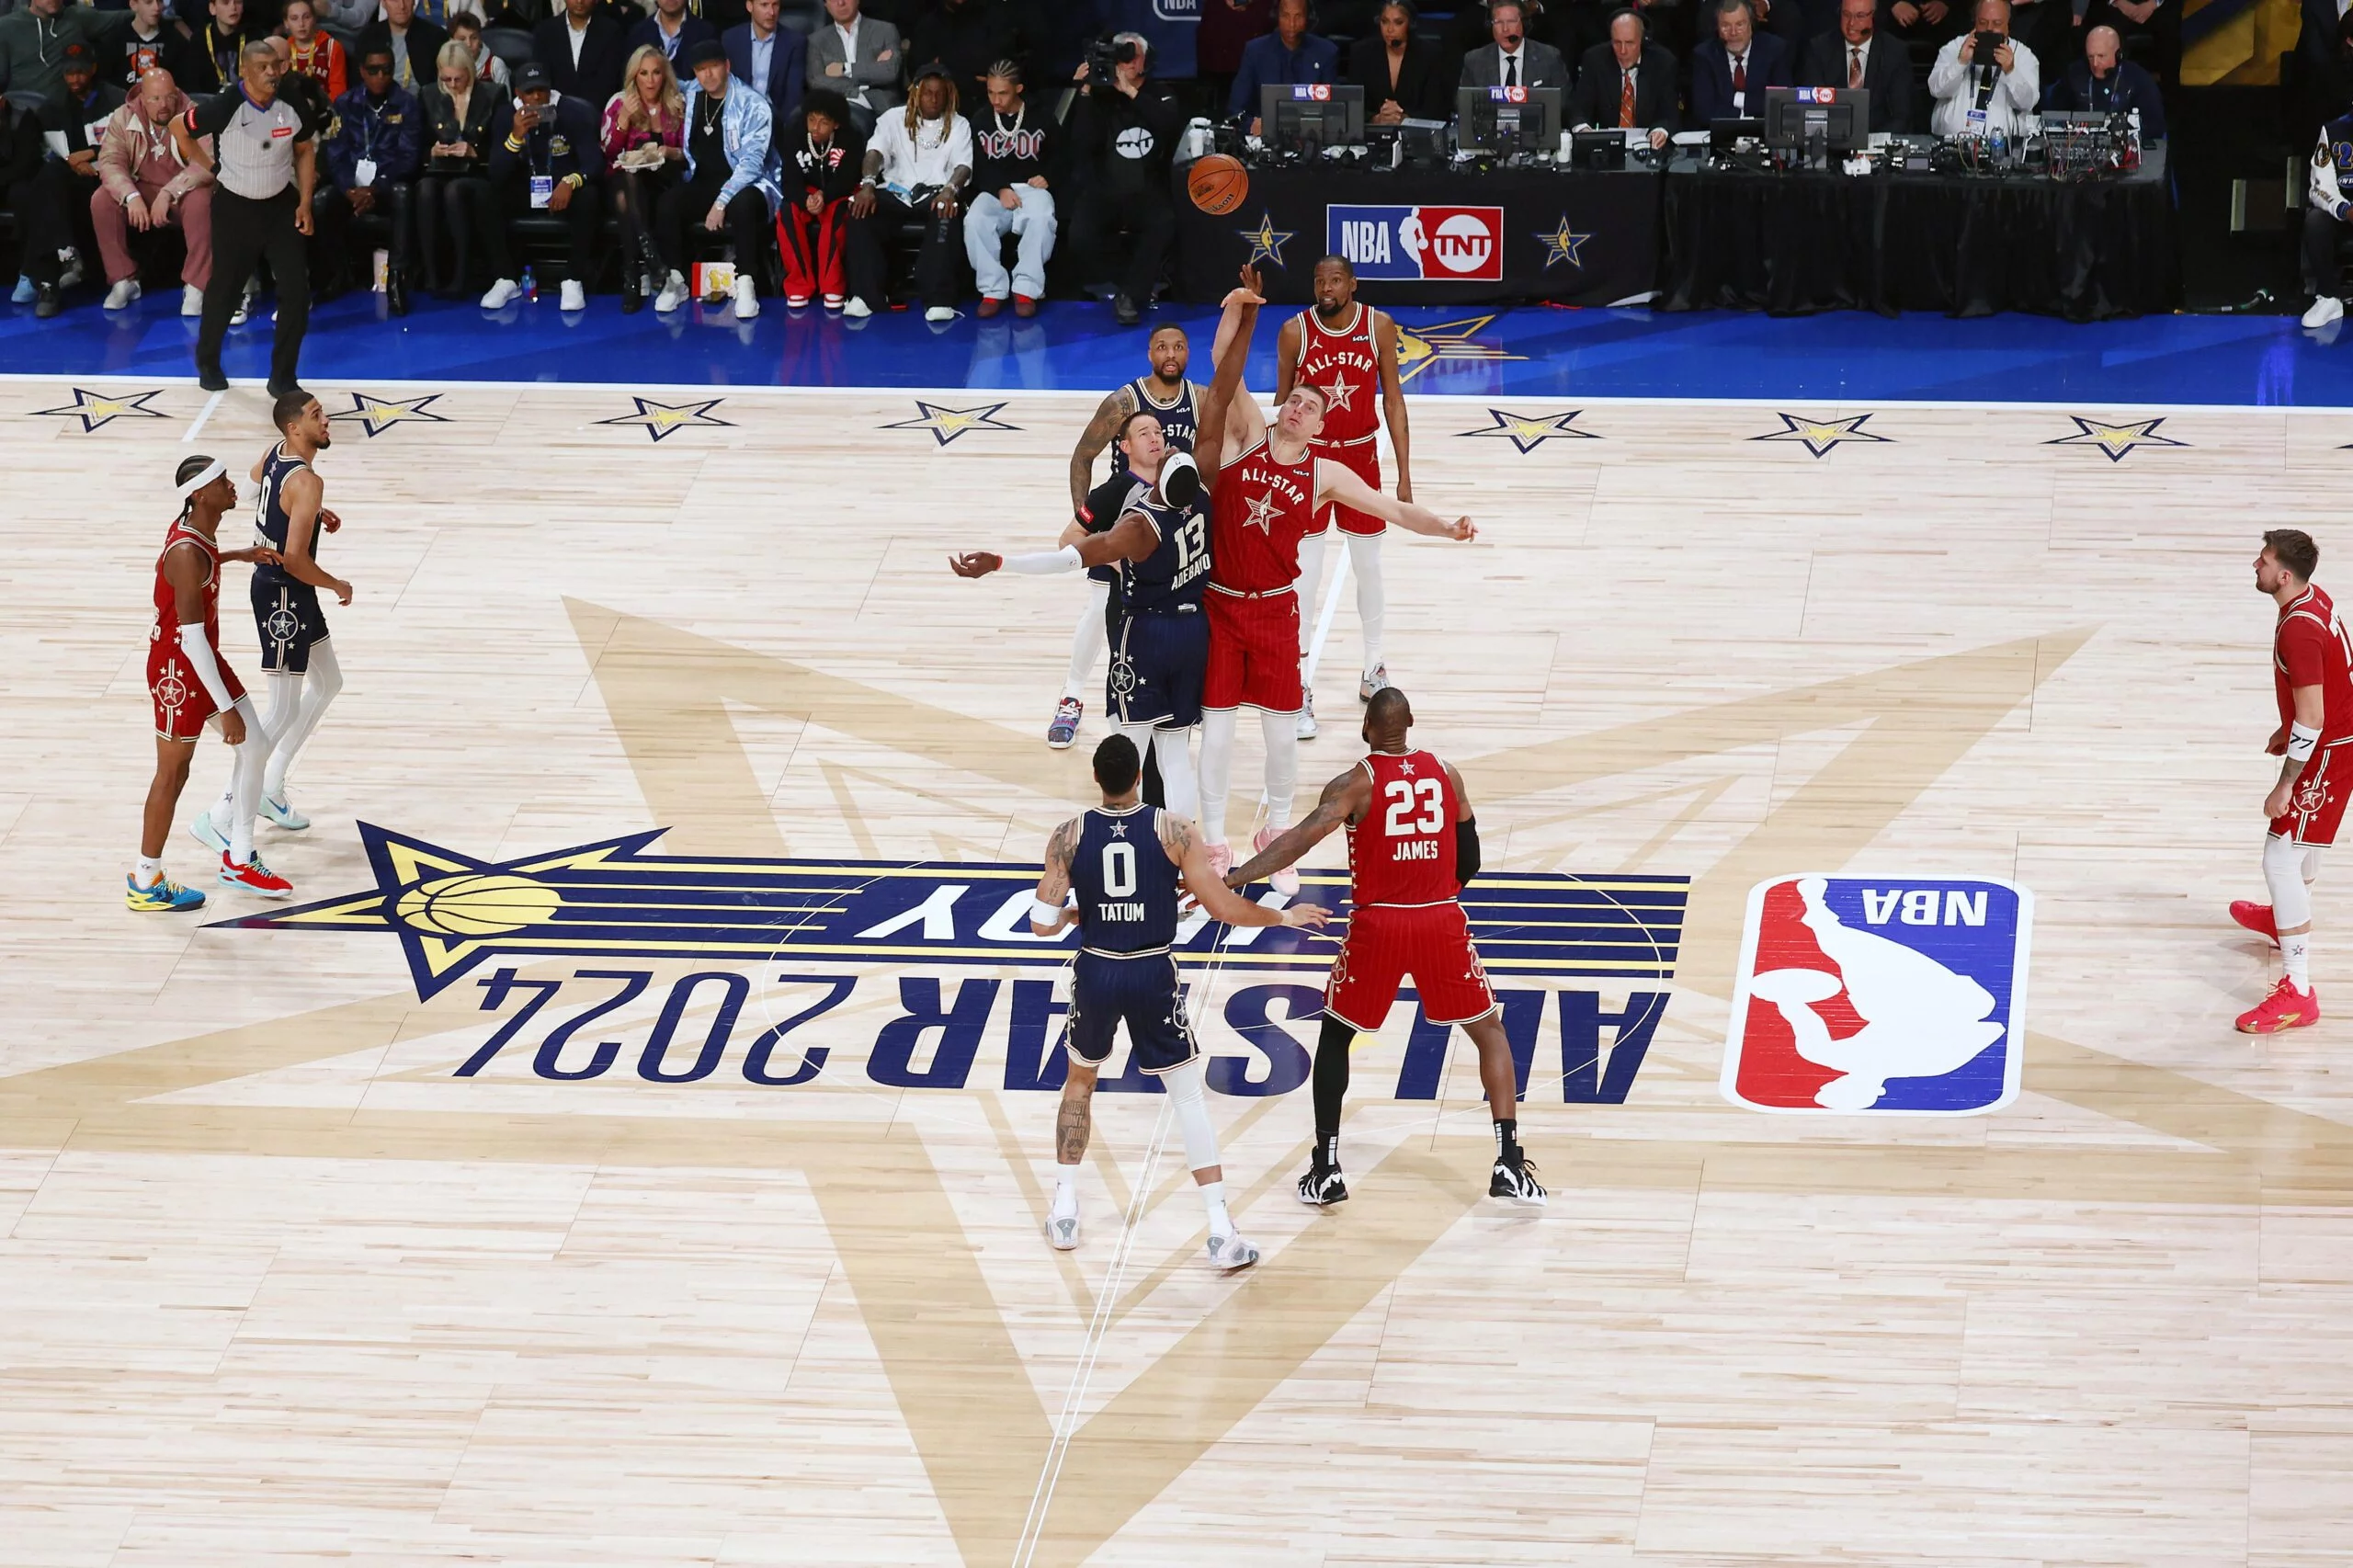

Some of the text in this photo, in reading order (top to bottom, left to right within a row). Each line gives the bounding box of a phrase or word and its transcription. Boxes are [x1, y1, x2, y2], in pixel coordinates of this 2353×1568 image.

[1341, 221, 1492, 264] NBA TNT
[1306, 352, 1373, 376] ALL-STAR
[257, 475, 272, 527] 0
[1242, 468, 1305, 506] ALL-STAR
[1174, 513, 1205, 570] 13
[1171, 552, 1211, 591] ADEBAYO
[2290, 733, 2314, 749] 77
[1384, 778, 1445, 837] 23
[1102, 841, 1137, 898] 0
[1392, 840, 1438, 861] JAMES
[1097, 903, 1145, 922] TATUM
[1861, 888, 1989, 926] NBA
[452, 967, 858, 1086] 2024
